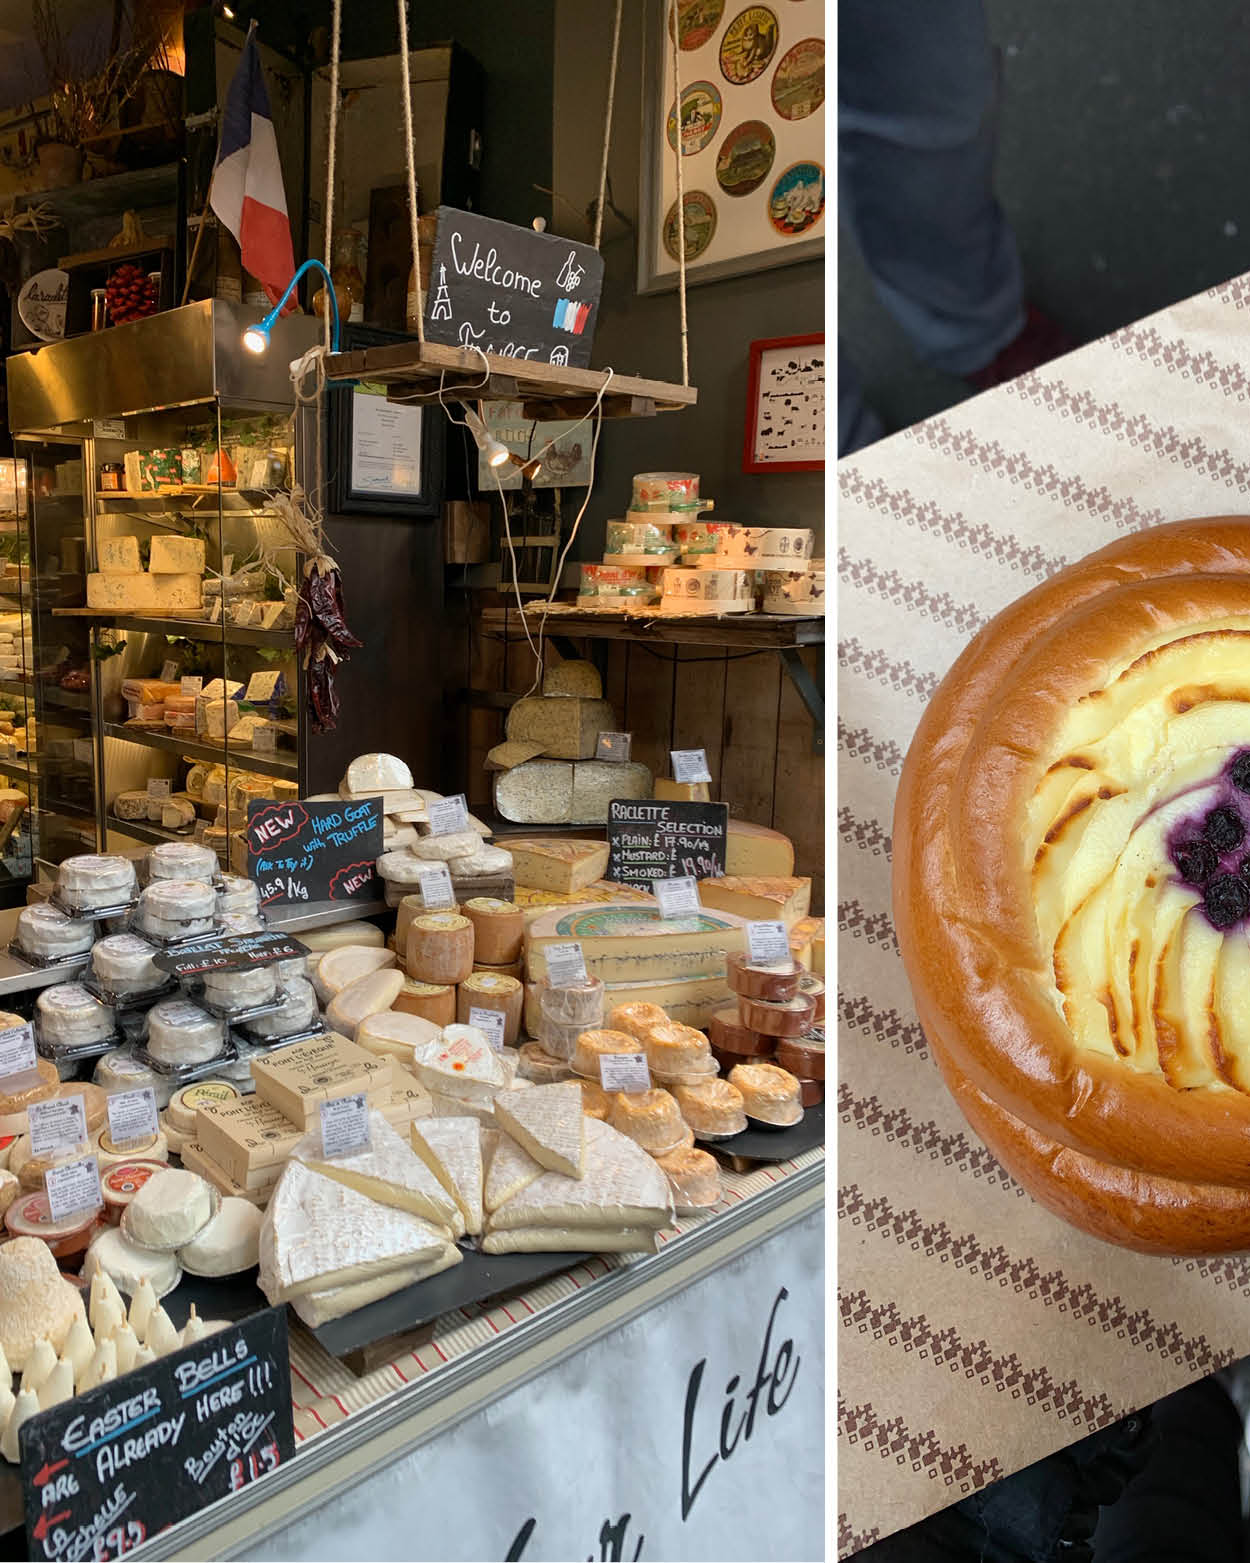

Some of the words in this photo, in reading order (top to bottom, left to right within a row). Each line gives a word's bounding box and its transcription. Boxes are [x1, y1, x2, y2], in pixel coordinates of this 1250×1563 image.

[451, 232, 542, 297] Welcome
[488, 301, 511, 325] to
[254, 809, 295, 843] NEW
[311, 813, 341, 835] HARD
[344, 802, 373, 822] GOAT
[611, 803, 671, 820] RACLETTE
[656, 820, 723, 835] SELECTION
[303, 838, 326, 853] with
[327, 814, 378, 847] TRUFFLE
[343, 868, 372, 894] NEW
[60, 1387, 162, 1452] EASTER
[175, 1339, 248, 1393] BELLS
[681, 1287, 800, 1522] Life
[41, 1474, 80, 1507] ARE
[96, 1411, 187, 1485] ALREADY
